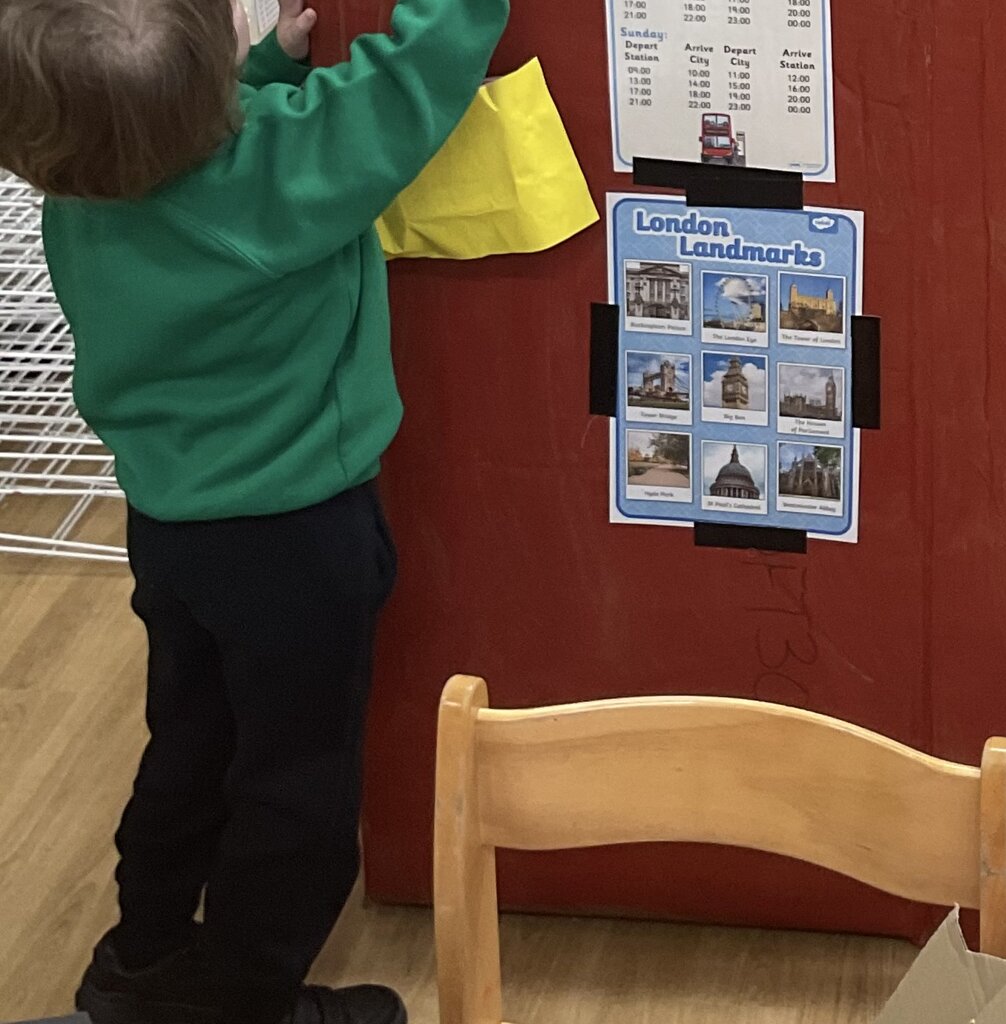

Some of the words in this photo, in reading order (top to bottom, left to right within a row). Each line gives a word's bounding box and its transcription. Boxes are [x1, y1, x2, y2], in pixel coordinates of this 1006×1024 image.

[620, 26, 668, 42] Sunday:
[625, 40, 658, 51] Depart
[684, 43, 714, 53] Arrive
[723, 45, 757, 56] Depart
[782, 49, 812, 58] Arrive
[624, 52, 660, 62] Station
[689, 55, 710, 67] City
[730, 57, 750, 69] City
[779, 60, 815, 70] Station
[635, 210, 731, 237] London
[679, 235, 823, 268] Landmarks
